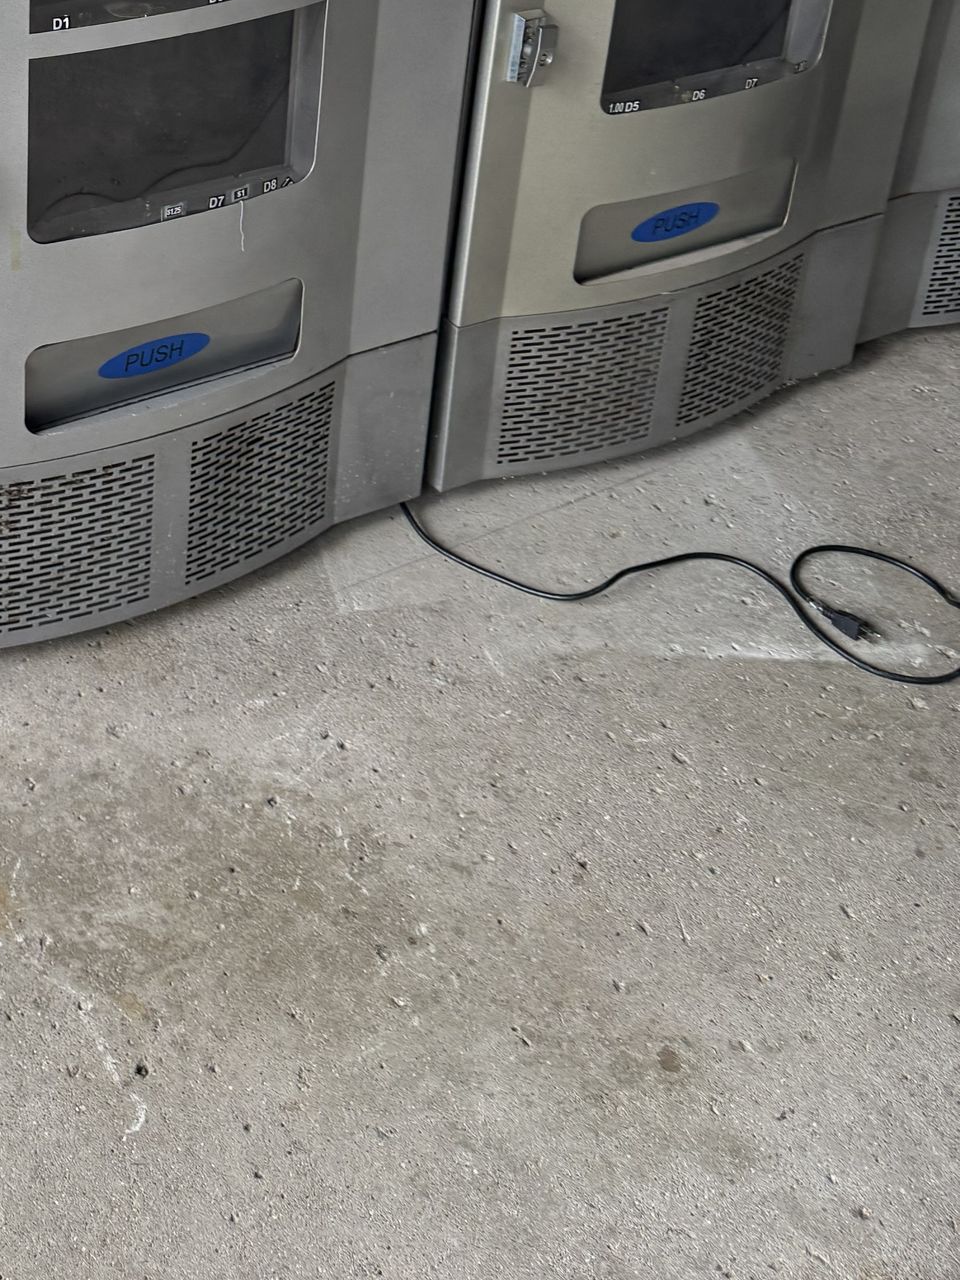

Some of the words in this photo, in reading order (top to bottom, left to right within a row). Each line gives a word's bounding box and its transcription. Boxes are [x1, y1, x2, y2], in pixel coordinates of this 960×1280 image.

[52, 16, 69, 31] D1
[745, 78, 758, 89] D7
[692, 89, 706, 101] D6
[608, 102, 624, 113] 1.00
[624, 101, 640, 112] D5
[263, 179, 277, 193] D8
[209, 195, 225, 209] D7
[651, 207, 700, 236] PUSH
[124, 339, 185, 373] PUSH
